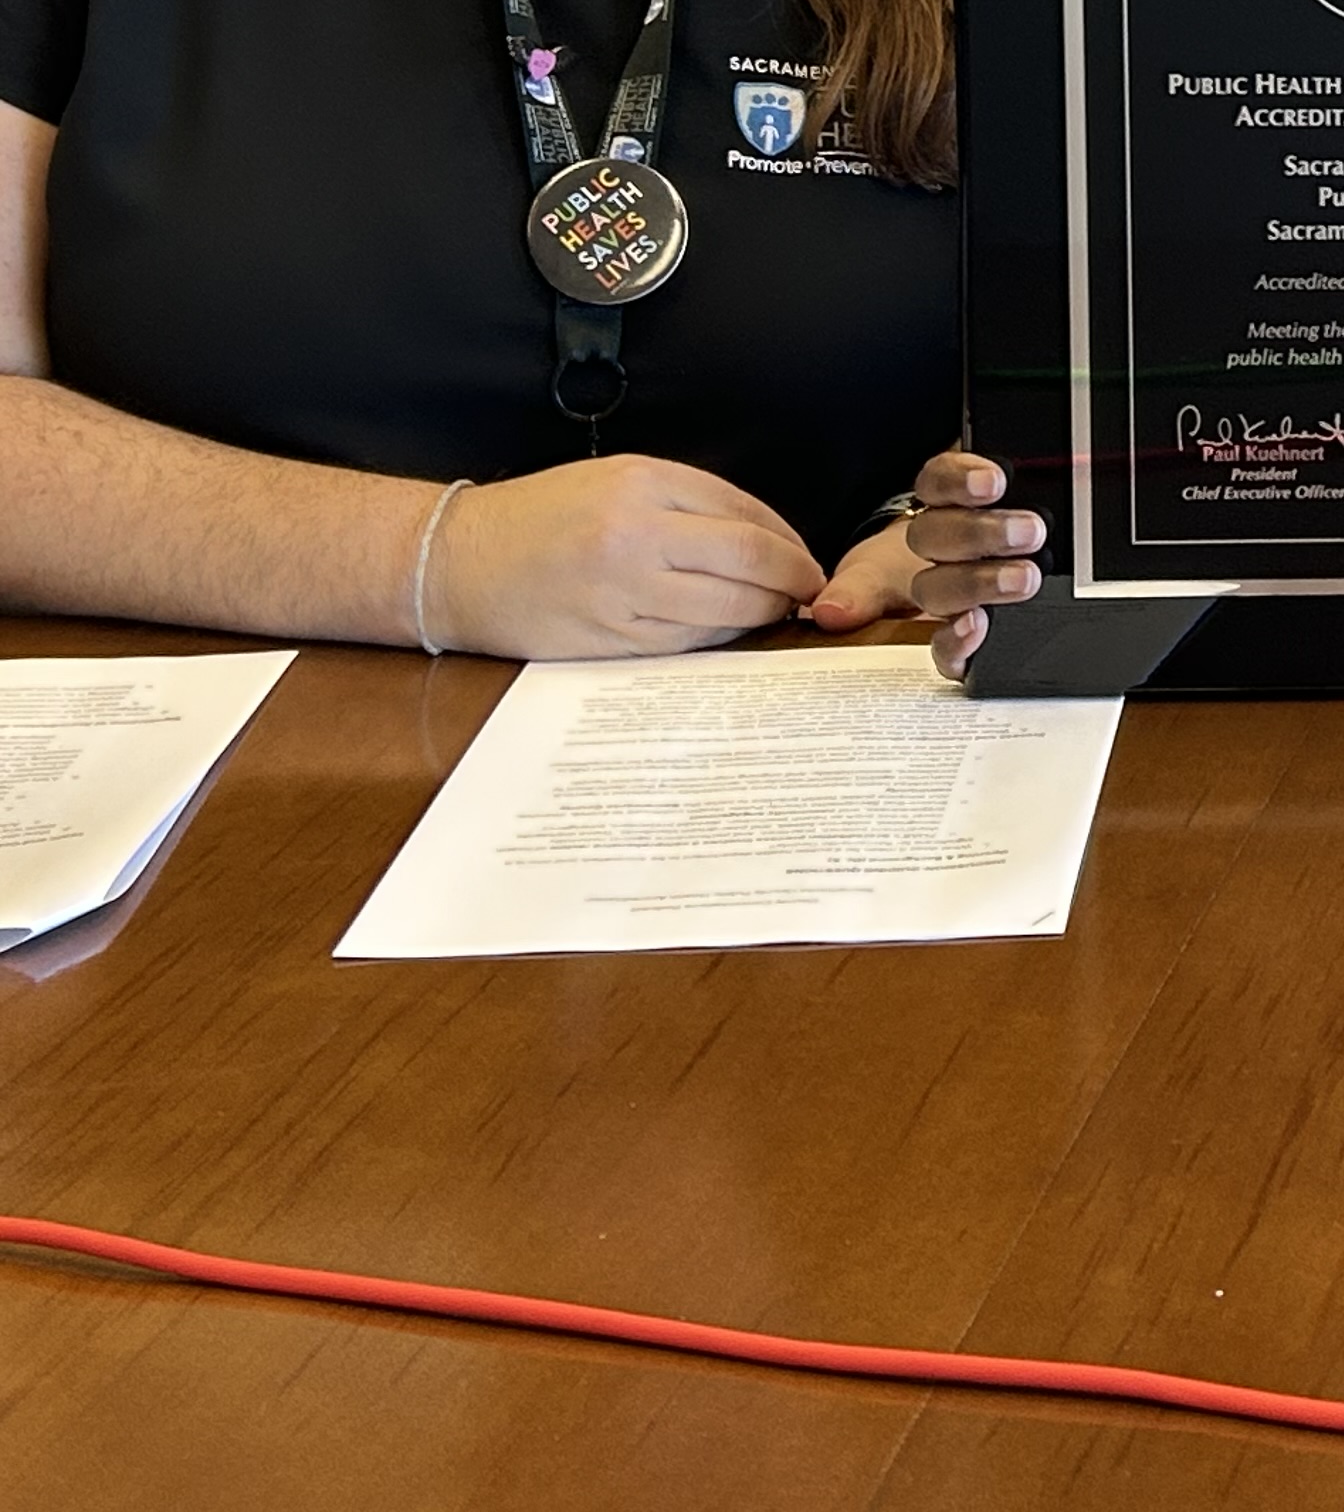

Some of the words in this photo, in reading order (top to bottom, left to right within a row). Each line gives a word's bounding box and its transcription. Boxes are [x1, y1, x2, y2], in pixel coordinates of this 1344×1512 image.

[729, 56, 834, 80] SACRAMEN
[1168, 73, 1248, 95] PUBLIC
[1256, 73, 1342, 95] HEALTH
[727, 150, 804, 174] Promote
[541, 167, 621, 235] PUBLIC
[559, 181, 644, 253] HEALTH
[577, 211, 647, 271] SAVES
[1247, 322, 1320, 343] Meeting
[1226, 347, 1283, 370] public
[1287, 347, 1343, 366] health
[1202, 445, 1241, 462] Paul
[1245, 444, 1325, 462] Kuehnert
[1230, 466, 1298, 482] President
[1182, 485, 1220, 500] Chief
[1224, 486, 1292, 500] Executive
